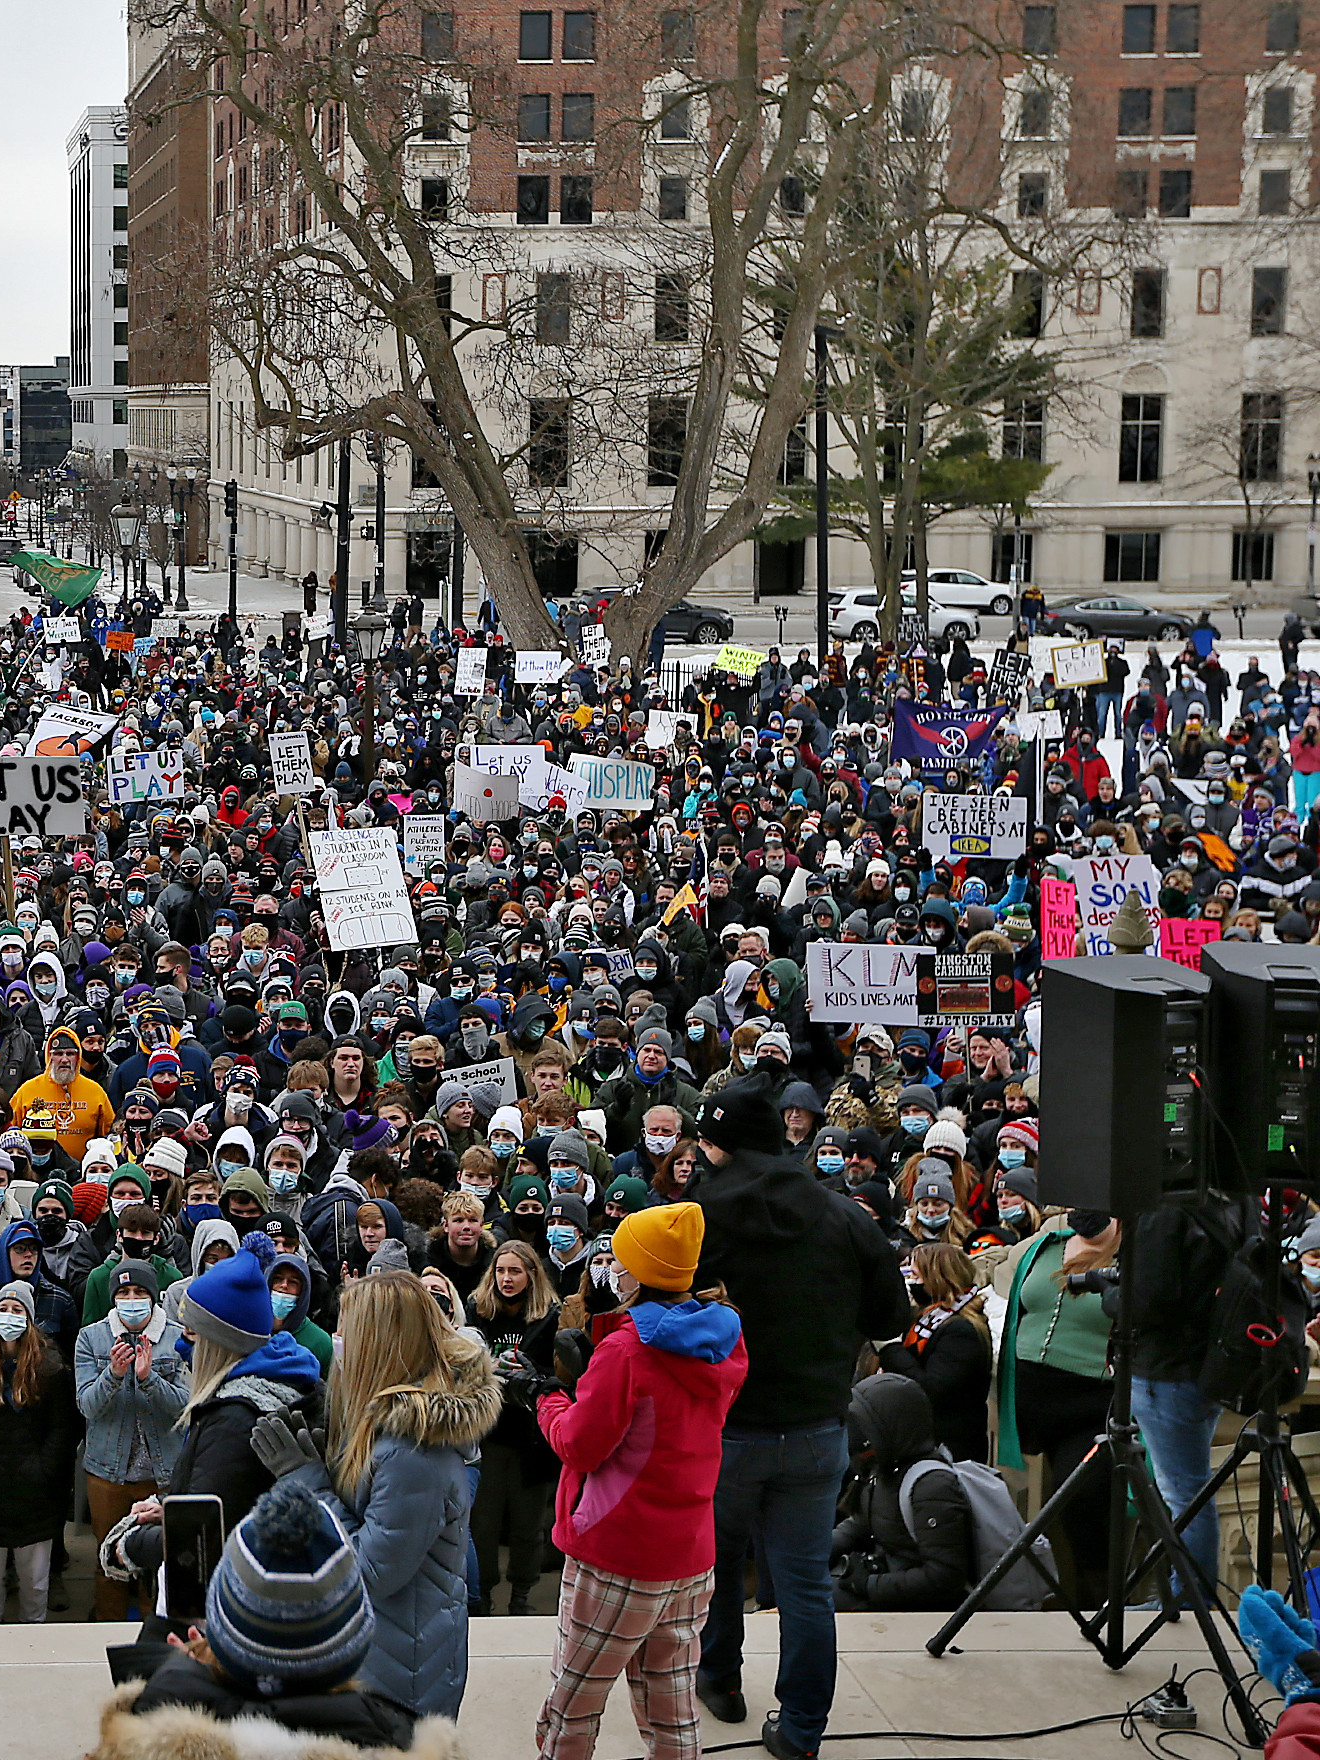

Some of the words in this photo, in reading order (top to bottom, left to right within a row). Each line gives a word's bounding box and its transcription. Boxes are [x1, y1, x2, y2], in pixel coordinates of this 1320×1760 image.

[901, 614, 922, 623] LET
[583, 626, 601, 638] LET
[899, 622, 925, 633] THEM
[584, 637, 605, 649] THEM
[996, 651, 1029, 671] LET
[1057, 646, 1087, 662] LET
[992, 667, 1027, 685] THEM
[991, 683, 1020, 699] PLAY
[51, 709, 104, 732] JACKSON
[916, 711, 961, 725] BOYNE
[278, 745, 305, 759] LET
[476, 746, 505, 766] Let
[111, 754, 150, 775] LET
[156, 750, 178, 769] US
[273, 758, 310, 772] THEM
[31, 764, 80, 803] US
[112, 770, 183, 800] PLAY
[276, 772, 308, 787] PLAY
[930, 796, 961, 808] I'VE
[970, 799, 1009, 812] SEEN
[937, 808, 997, 823] BETTER
[322, 832, 337, 841] MI
[339, 829, 384, 841] SCIENCE??
[927, 820, 1007, 837] CABINETS
[1009, 822, 1026, 837] AT
[314, 845, 322, 855] 12
[324, 841, 367, 855] STUDENTS
[367, 839, 380, 850] IN
[385, 839, 392, 848] A
[957, 838, 983, 853] IKEA
[340, 852, 388, 864] CLASSROOM
[1090, 858, 1131, 882] MY
[325, 897, 333, 906] 12
[336, 892, 376, 906] STUDENTS
[378, 891, 391, 899] ON
[396, 889, 408, 898] AN
[1047, 885, 1070, 906] LET
[1089, 881, 1152, 907] SON
[349, 904, 366, 914] ICE
[371, 900, 396, 910] RINK
[1047, 910, 1075, 928] THEM
[1168, 925, 1213, 946] LET
[1047, 933, 1076, 958] PLAY
[935, 953, 992, 966] KINGSTON
[820, 948, 918, 988] KLM
[934, 964, 992, 977] CARDINALS
[824, 991, 856, 1008] KIDS
[860, 992, 889, 1007] LIVES
[924, 1015, 1013, 1026] #LETUSPLAY
[461, 1064, 501, 1081] School
